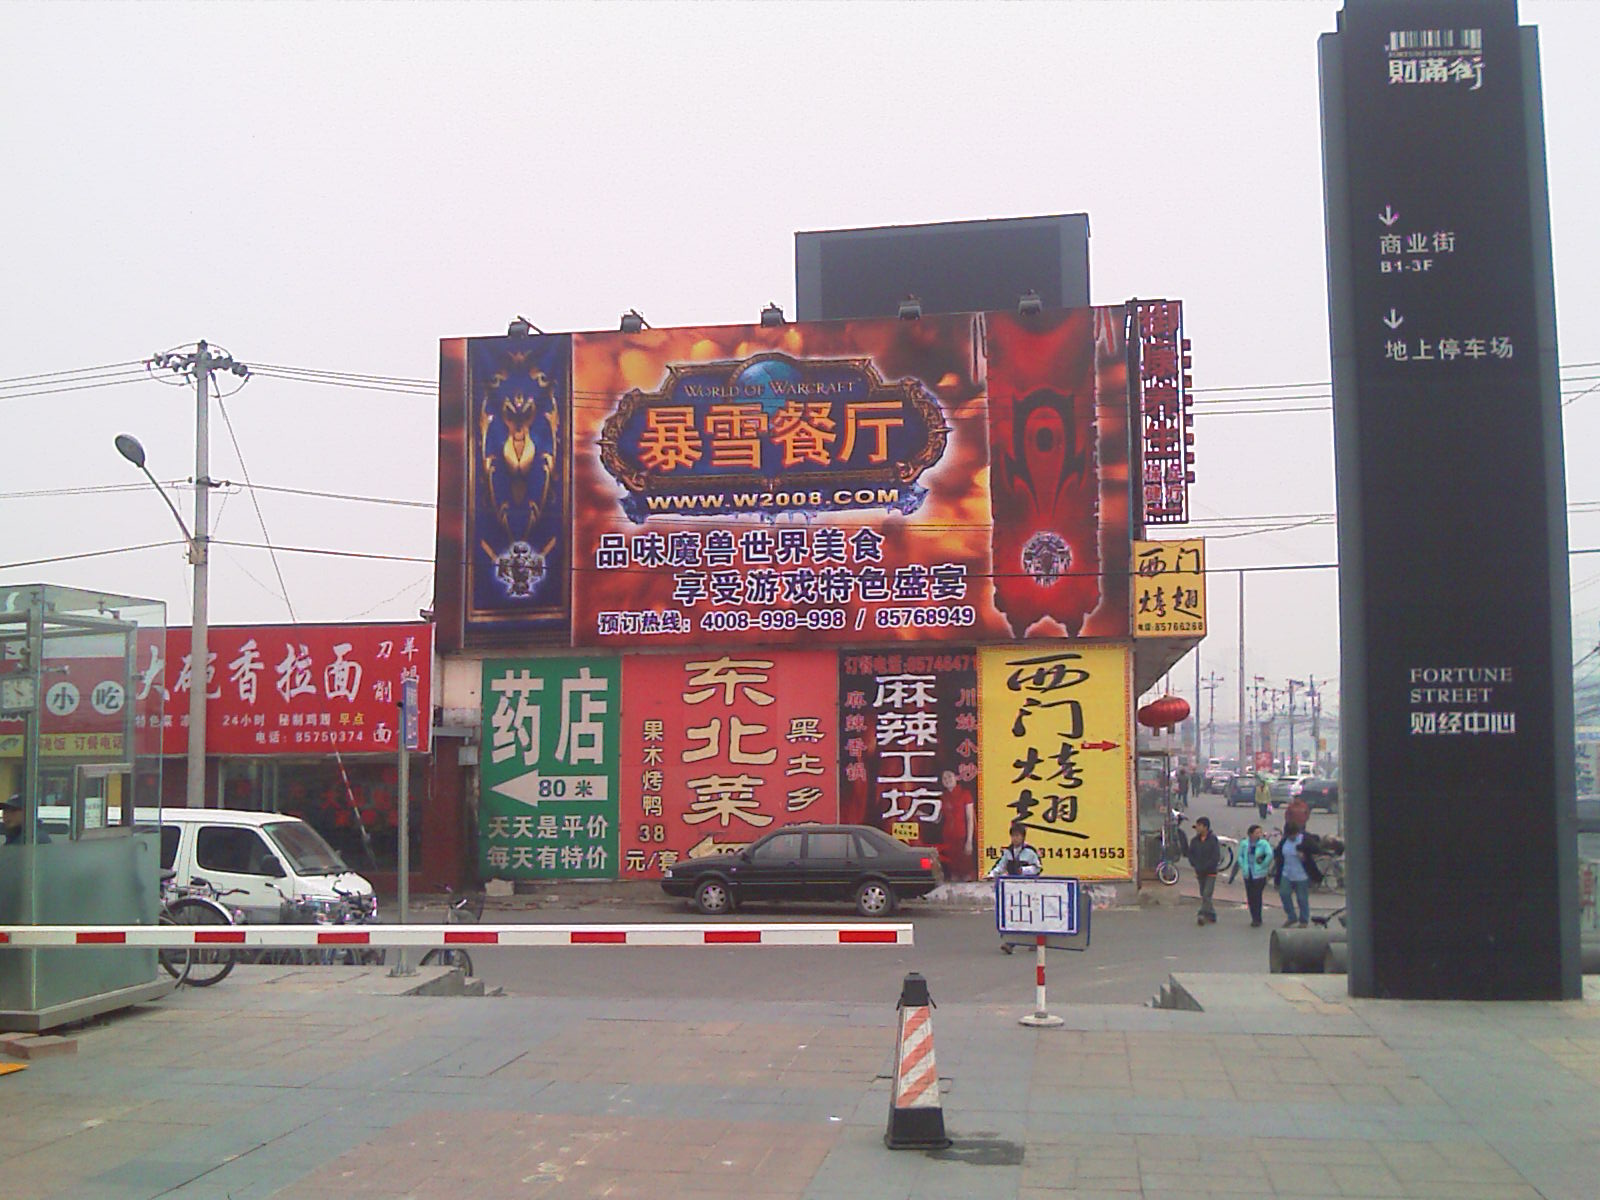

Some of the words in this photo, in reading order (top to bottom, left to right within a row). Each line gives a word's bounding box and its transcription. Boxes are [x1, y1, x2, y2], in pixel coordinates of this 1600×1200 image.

[1380, 230, 1455, 255] 商业街
[1381, 259, 1432, 273] B1-3F
[1385, 336, 1513, 361] 地上停车场
[684, 384, 739, 398] WORLD
[744, 384, 765, 397] OF
[769, 380, 853, 397] WARCRAFT
[639, 400, 905, 470] 暴雪餐厅
[646, 489, 899, 511] WWW.W2008.COM
[597, 528, 884, 569] 品味魔兽世界美食
[1138, 547, 1201, 578] 西门
[673, 565, 968, 606] 享受游戏特色盛宴
[1138, 585, 1202, 619] 烤翅
[700, 608, 845, 632] 4008-998-998
[1409, 667, 1512, 683] FORTUNE
[53, 686, 119, 710] 小吃
[372, 640, 393, 743] 刀削面
[1410, 687, 1493, 703] STREET
[222, 713, 265, 727] 24小时
[339, 711, 365, 726] 早点
[491, 667, 609, 766] 药店
[1410, 711, 1515, 735] 财经中心
[681, 656, 778, 827] 东北菜
[872, 673, 944, 822] 麻辣工坊
[1005, 653, 1090, 839] 西门烤翅
[641, 718, 665, 818] 果木烤鸭
[785, 717, 825, 827] 黑土乡
[538, 779, 566, 798] 80
[574, 779, 593, 798] 米
[487, 814, 609, 840] 天天是平价
[639, 824, 666, 844] 38
[486, 845, 609, 871] 每天有特价
[1010, 890, 1062, 924] 出口
